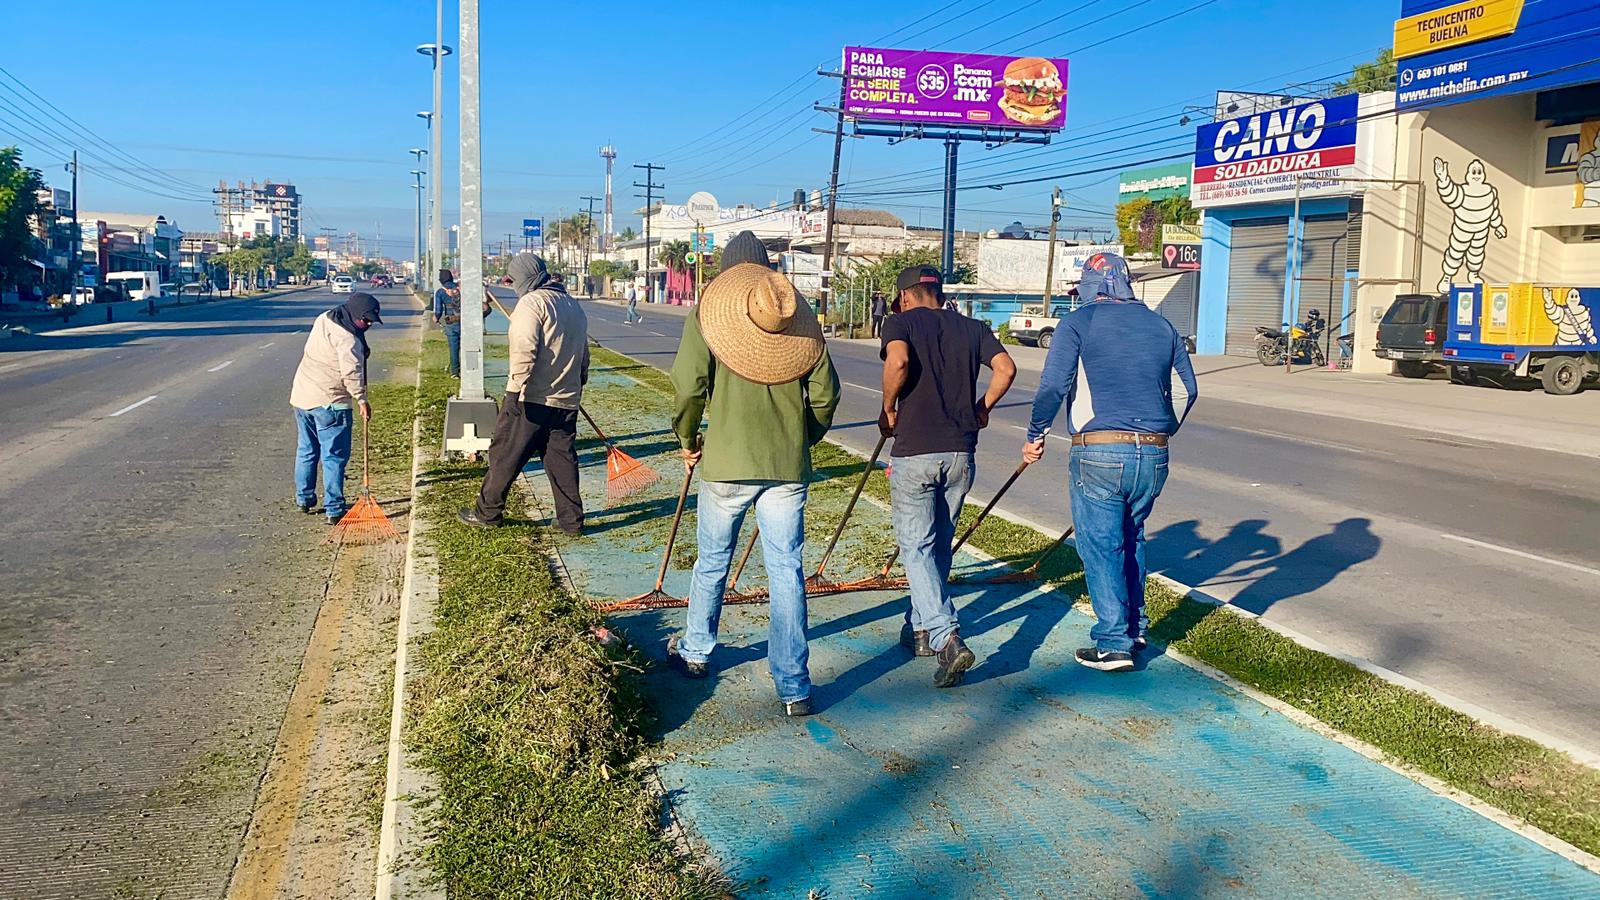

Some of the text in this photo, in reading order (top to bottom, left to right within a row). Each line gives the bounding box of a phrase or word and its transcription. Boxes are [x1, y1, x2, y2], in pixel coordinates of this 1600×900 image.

[1417, 6, 1484, 32] TECNICENTRO
[1430, 25, 1468, 43] BUELNA
[851, 52, 883, 64] PARA
[850, 64, 906, 79] ECHARSE
[953, 64, 993, 79] Panama
[1417, 61, 1467, 80] 669 101 0881
[850, 79, 900, 90] LA SERIE
[920, 74, 945, 91] $35
[850, 89, 919, 104] COMPLETA.
[1213, 103, 1325, 162] CANO
[1213, 152, 1321, 180] SOLDADURA
[1178, 245, 1198, 262] 16c
